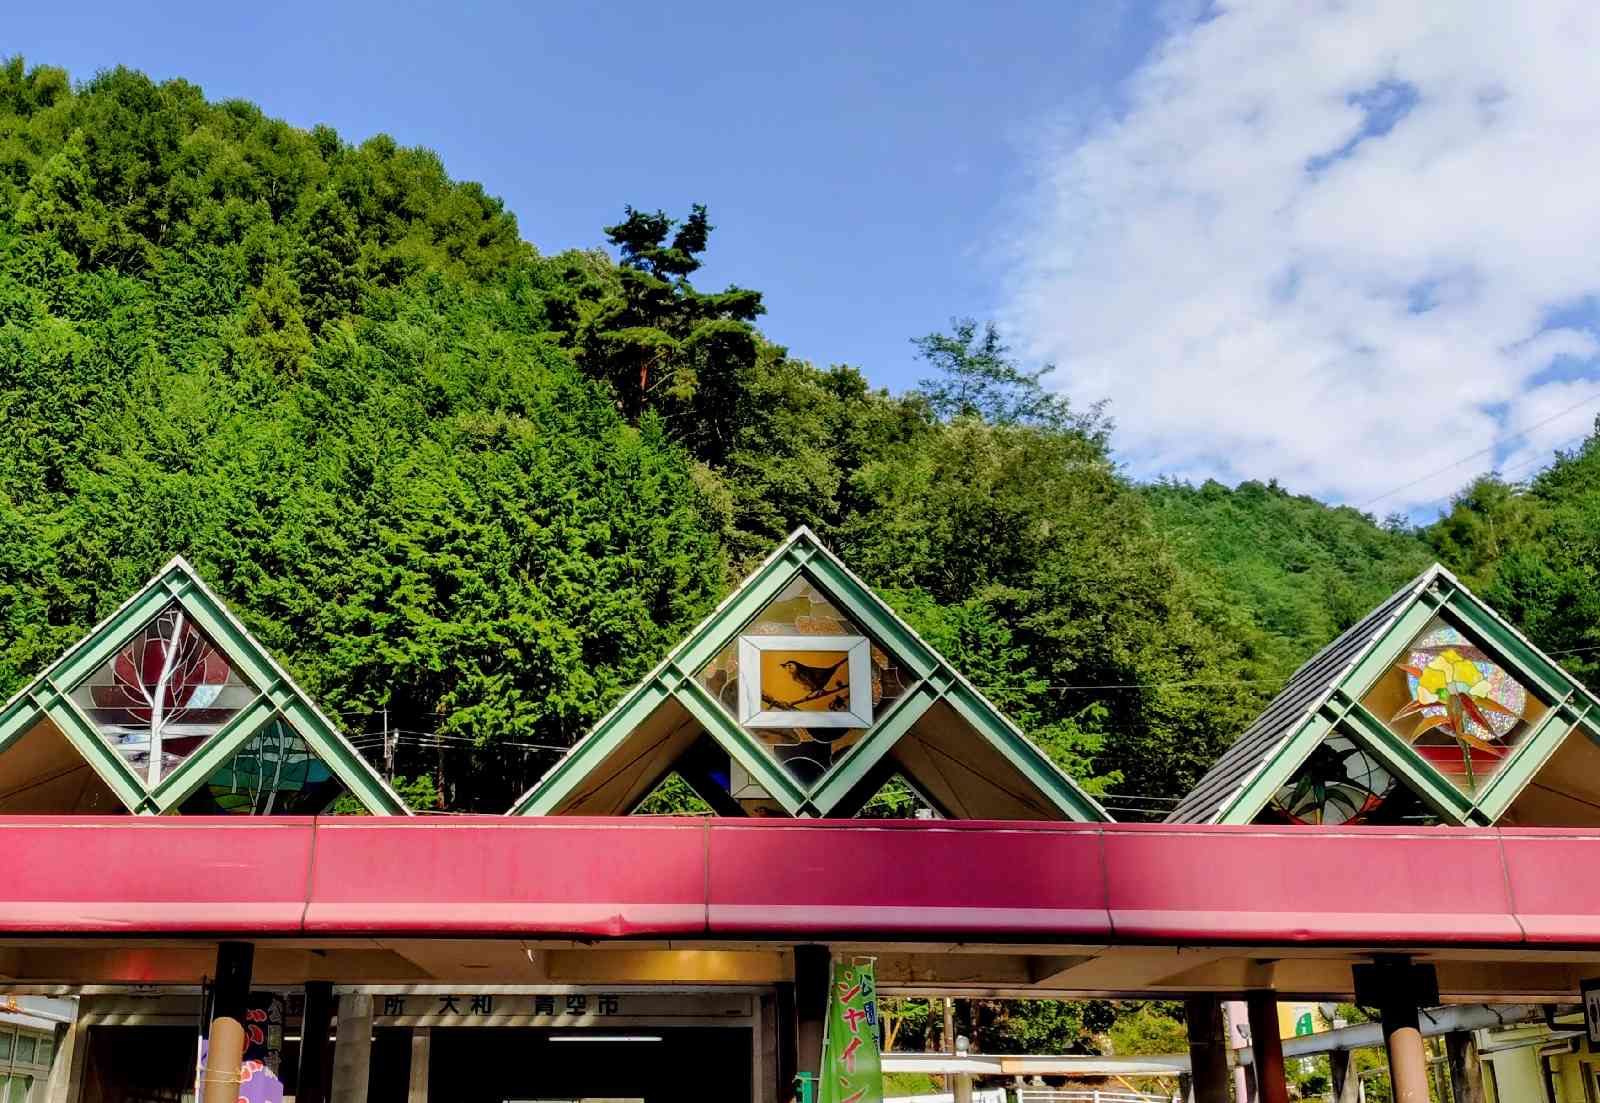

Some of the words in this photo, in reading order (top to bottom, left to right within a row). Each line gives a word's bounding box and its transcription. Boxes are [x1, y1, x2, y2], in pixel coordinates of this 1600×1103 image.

[438, 994, 493, 1016] 大和
[534, 994, 619, 1016] 青空市
